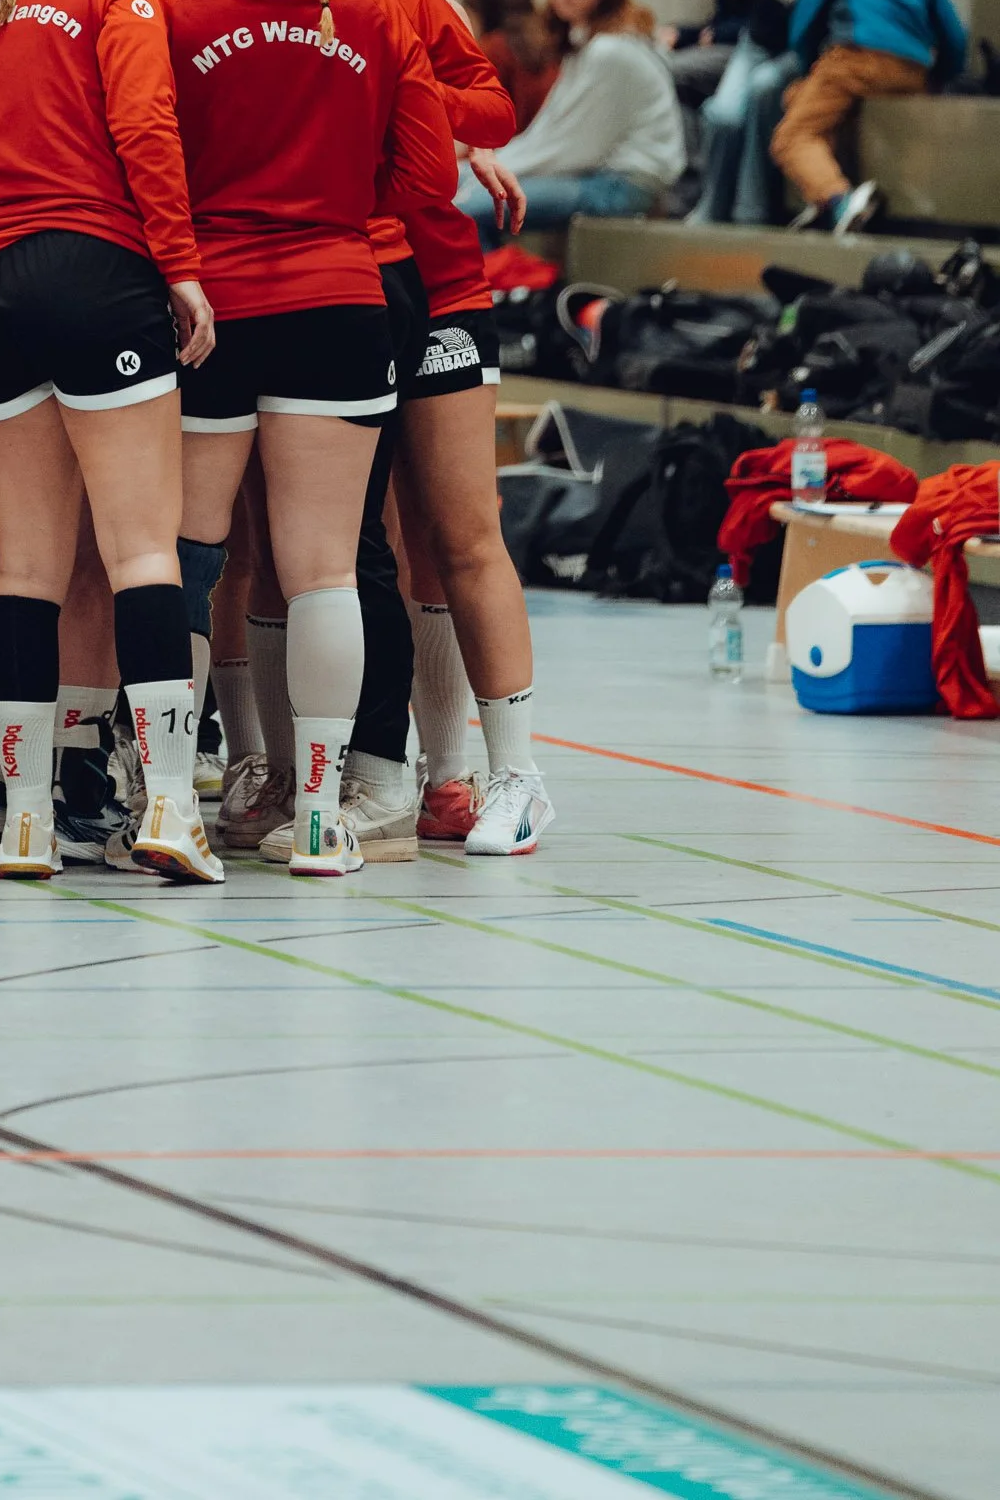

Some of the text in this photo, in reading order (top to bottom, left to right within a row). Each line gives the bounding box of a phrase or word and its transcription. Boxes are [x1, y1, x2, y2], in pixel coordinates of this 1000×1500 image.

[191, 20, 367, 75] MTG Wangen
[426, 344, 445, 357] FEN
[2, 724, 23, 778] Kempa
[134, 707, 152, 765] Kempa
[303, 742, 331, 794] Kempa
